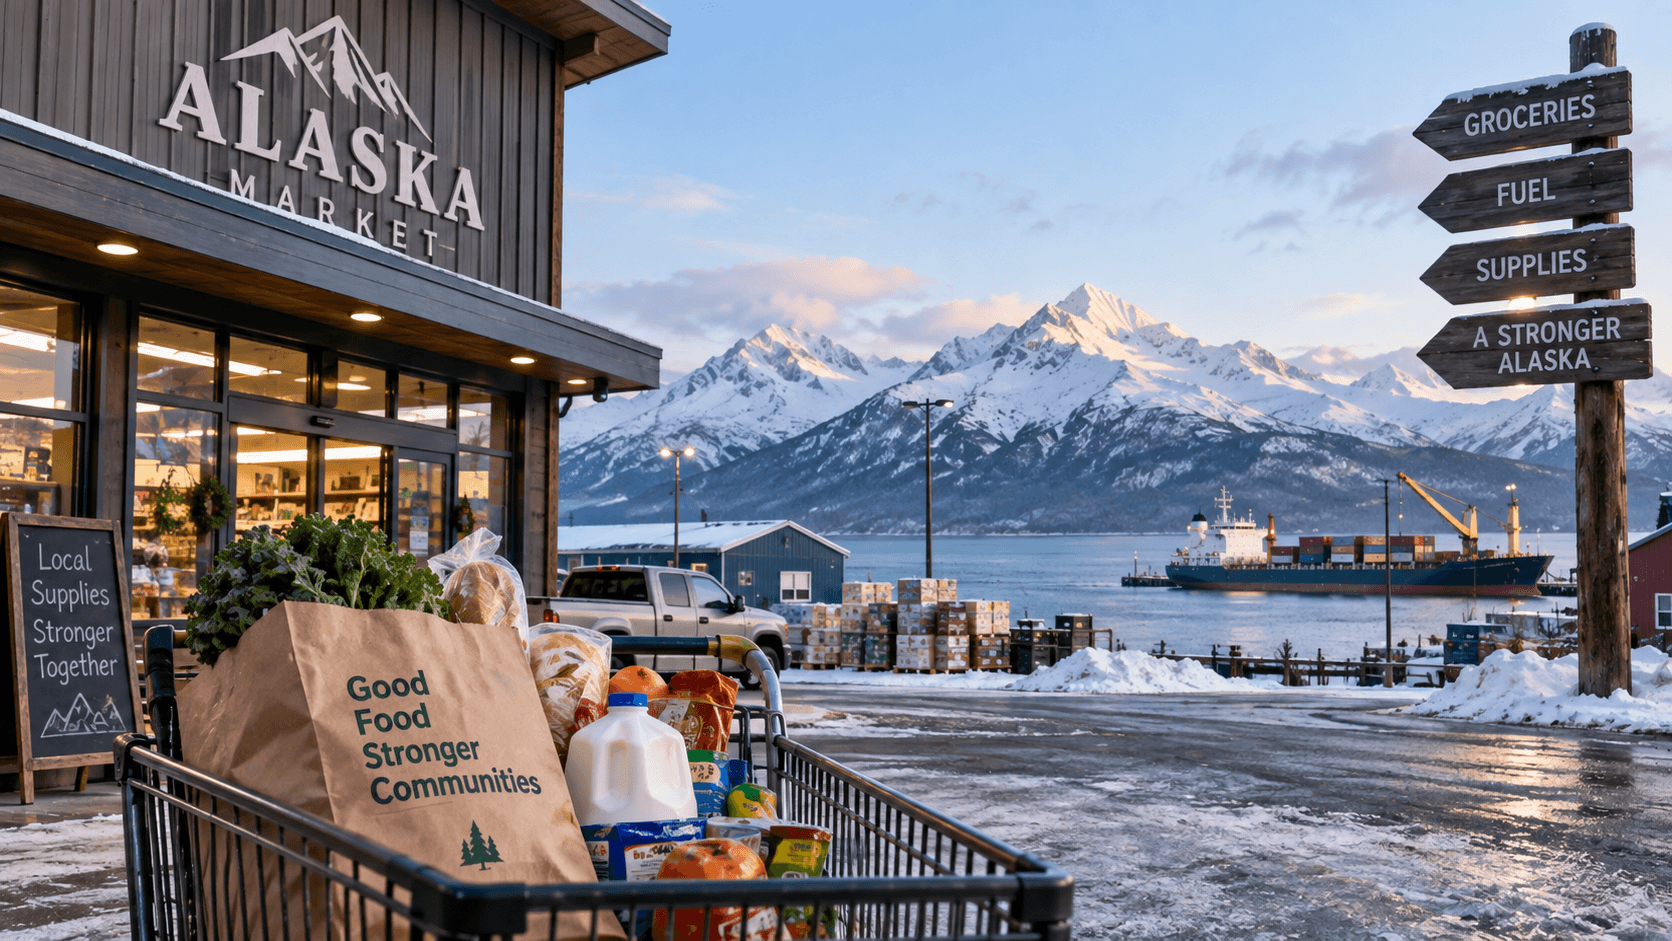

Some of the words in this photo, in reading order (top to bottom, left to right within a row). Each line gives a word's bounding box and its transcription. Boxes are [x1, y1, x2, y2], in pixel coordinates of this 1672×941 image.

[1464, 94, 1596, 137] GROCERIES
[157, 61, 485, 231] ALASKA
[1497, 177, 1556, 206] FUEL
[228, 168, 438, 257] MARKET
[1476, 248, 1588, 282] SUPPLIES
[1472, 326, 1489, 348] A
[1498, 316, 1621, 346] STRONGER
[1498, 347, 1592, 374] ALASKA
[39, 543, 92, 571] Local
[31, 579, 110, 613] Supplies
[33, 618, 114, 650] Stronger
[33, 652, 118, 685] Together
[346, 669, 430, 701] Good
[353, 702, 432, 736] Food
[362, 741, 480, 769] Stronger
[370, 767, 542, 805] Communities
